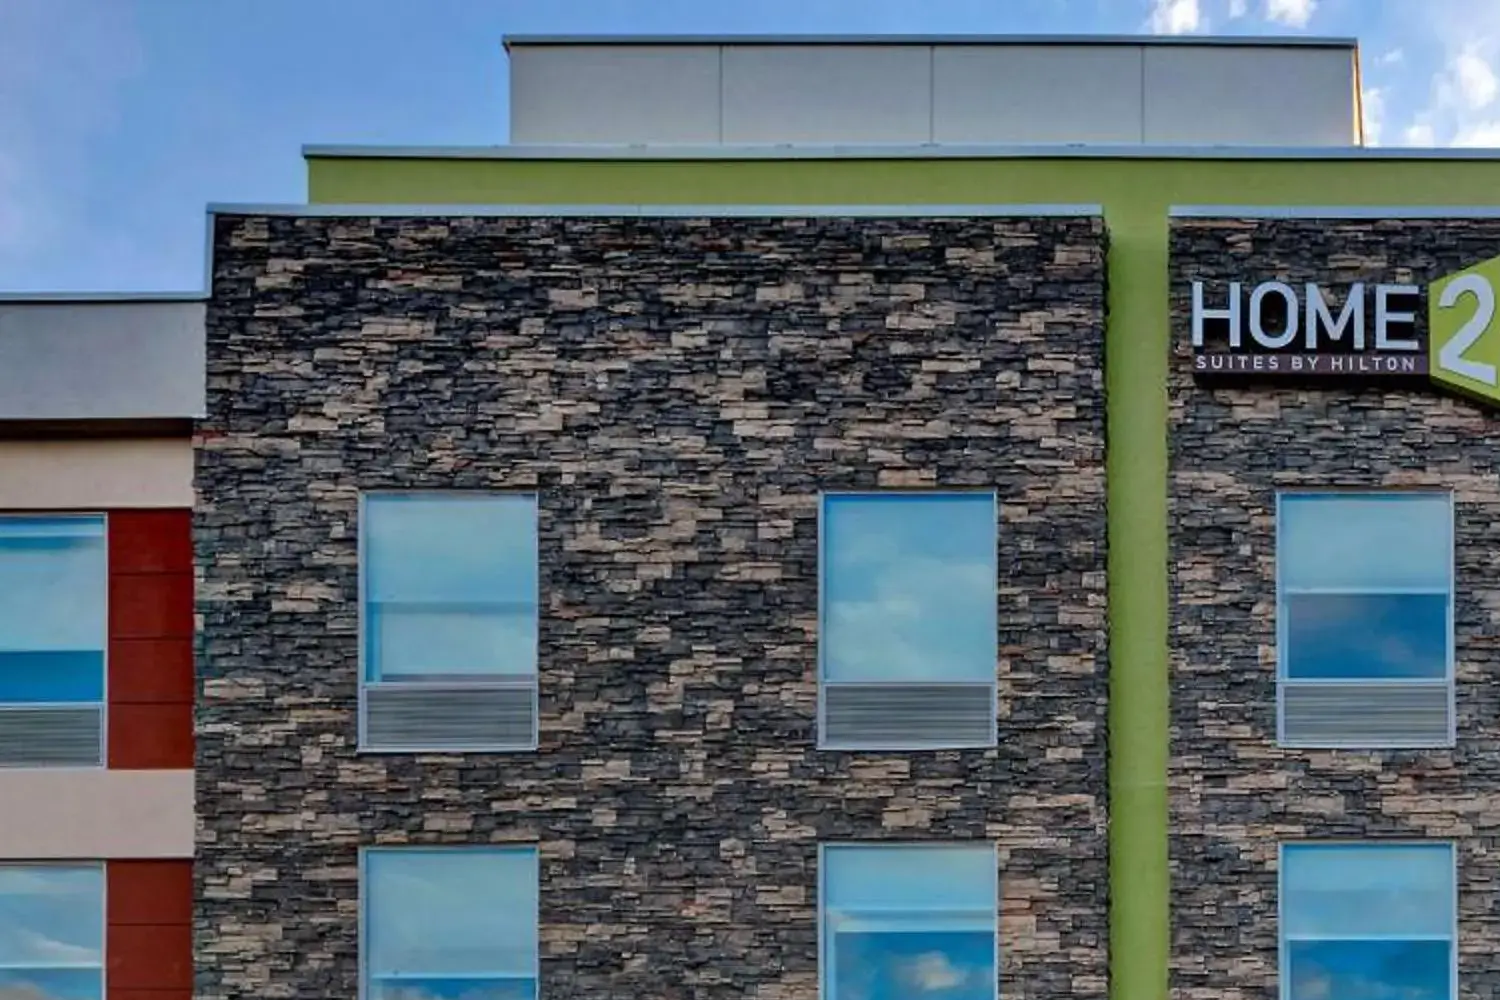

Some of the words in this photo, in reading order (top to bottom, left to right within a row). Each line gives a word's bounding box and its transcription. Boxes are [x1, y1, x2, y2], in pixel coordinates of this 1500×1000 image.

[1192, 281, 1419, 350] HOME
[1438, 273, 1497, 386] 2
[1196, 355, 1279, 369] SUITES
[1291, 356, 1319, 371] BY
[1331, 356, 1415, 371] HILTON
